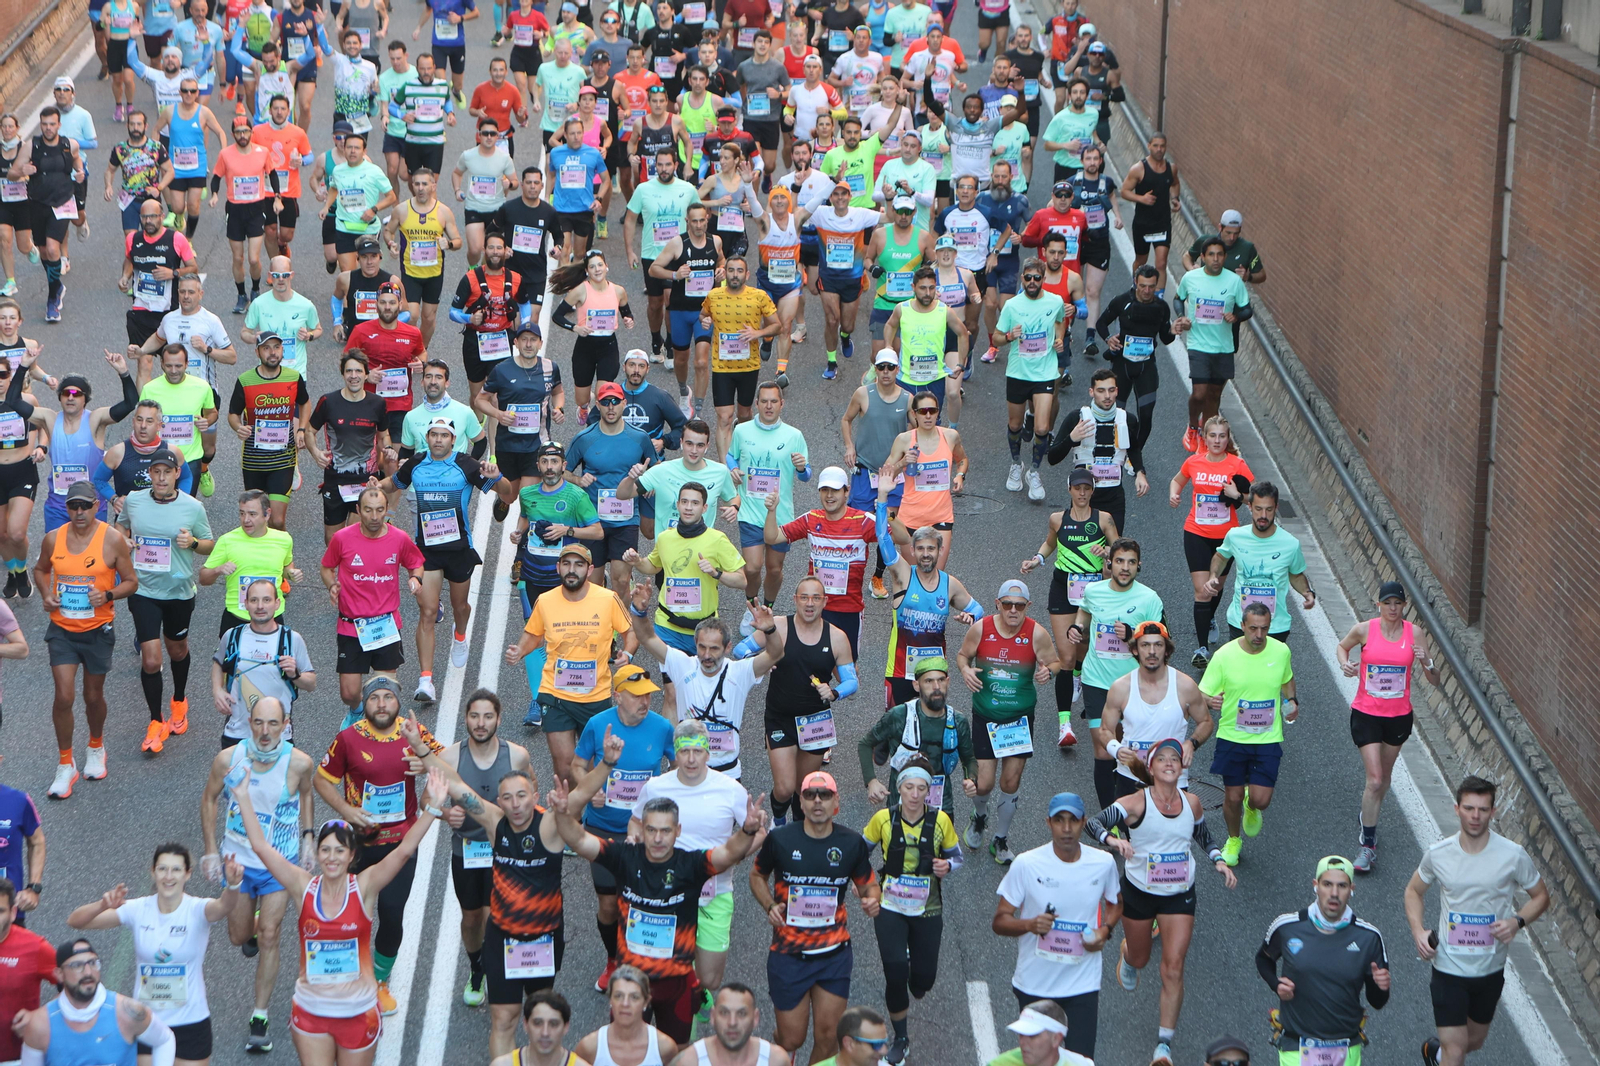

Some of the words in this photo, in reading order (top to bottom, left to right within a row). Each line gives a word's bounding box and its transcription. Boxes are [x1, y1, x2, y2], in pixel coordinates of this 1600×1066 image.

[956, 145, 984, 154] AGUALVA
[956, 150, 984, 159] RUNNERS
[406, 228, 438, 236] TANINOS
[254, 394, 290, 408] Gorras
[254, 405, 290, 416] runners
[517, 404, 538, 412] ZURICH
[1195, 472, 1207, 481] 10
[431, 512, 451, 520] ZURICH
[66, 585, 89, 593] ZURICH
[372, 633, 386, 641] PABLO
[1251, 701, 1272, 709] ZURICH
[809, 710, 832, 722] ZURICH
[623, 773, 649, 781] ZURICH
[378, 787, 401, 795] ZURICH
[1164, 854, 1186, 862] ZURICH
[783, 873, 849, 886] JARTIBLES
[899, 875, 925, 887] ZURICH
[805, 888, 832, 896] ZURICH
[621, 888, 685, 907] JARTIBLES
[804, 902, 821, 910] 6973
[801, 910, 823, 918] GUILLEN
[643, 914, 670, 925] ZURICH
[1464, 916, 1490, 924] ZURICH
[1057, 922, 1083, 931] ZURICH
[642, 929, 658, 938] 6540
[643, 939, 655, 947] EDU
[1054, 936, 1071, 945] 8092
[323, 942, 352, 951] ZURICH
[1049, 944, 1073, 954] YOUSSEF
[153, 967, 181, 975] ZURICH
